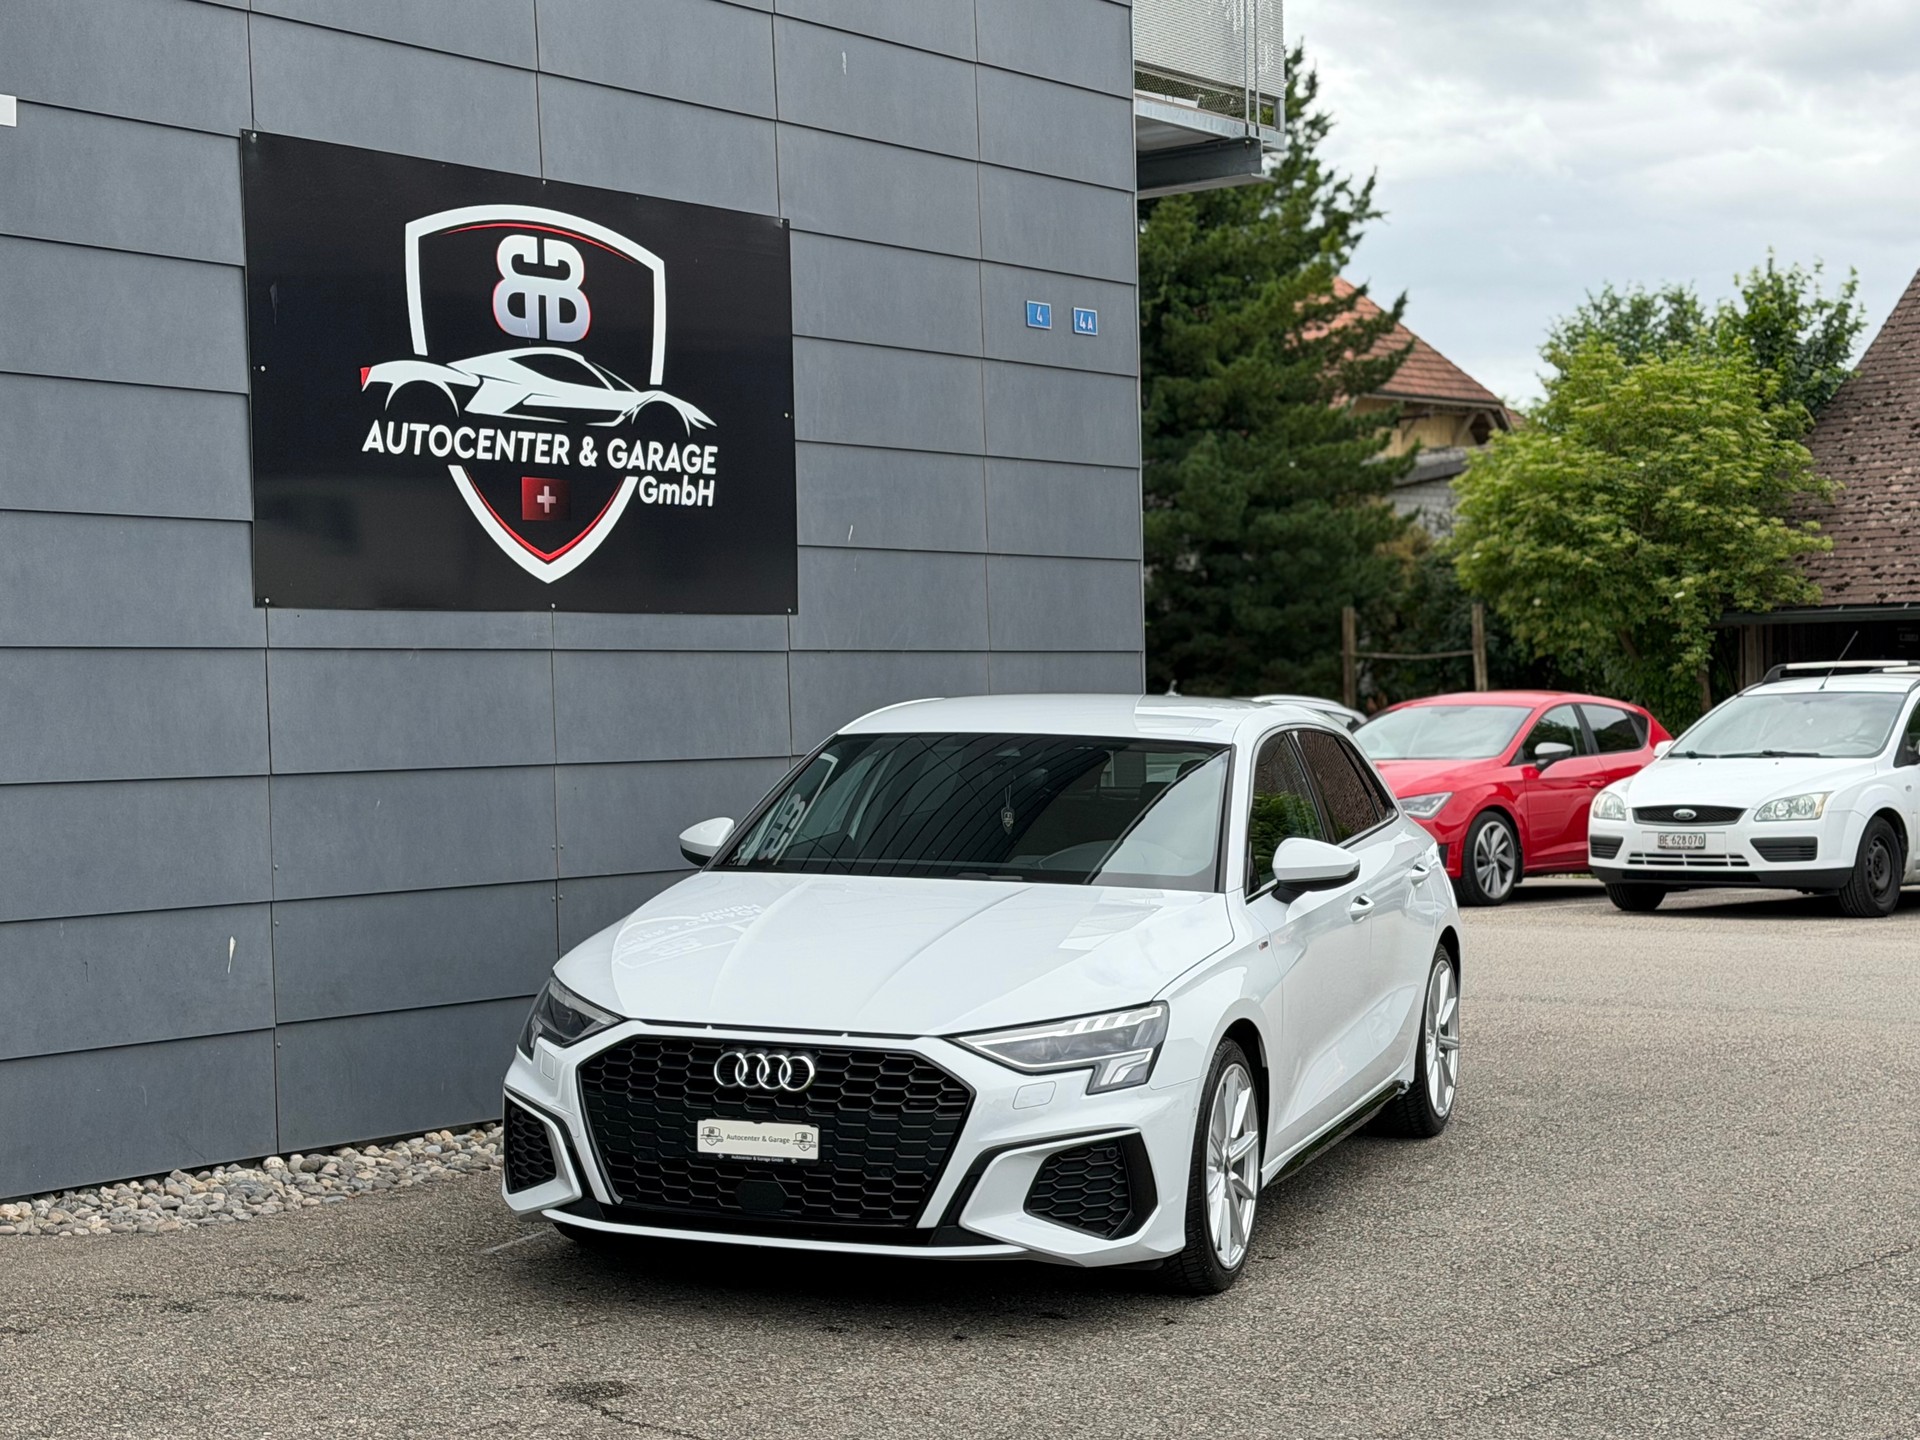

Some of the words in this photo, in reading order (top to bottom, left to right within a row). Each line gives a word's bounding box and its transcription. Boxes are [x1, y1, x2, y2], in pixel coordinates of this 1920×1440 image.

[1036, 306, 1043, 323] 4
[1079, 312, 1094, 330] 4A
[361, 419, 570, 465] AUTOCENTER
[578, 436, 598, 468] &
[607, 438, 718, 475] GARAGE
[638, 474, 716, 508] GmbH
[1659, 834, 1669, 846] BE
[726, 1133, 761, 1142] Autocenter
[768, 1136, 791, 1144] Garage
